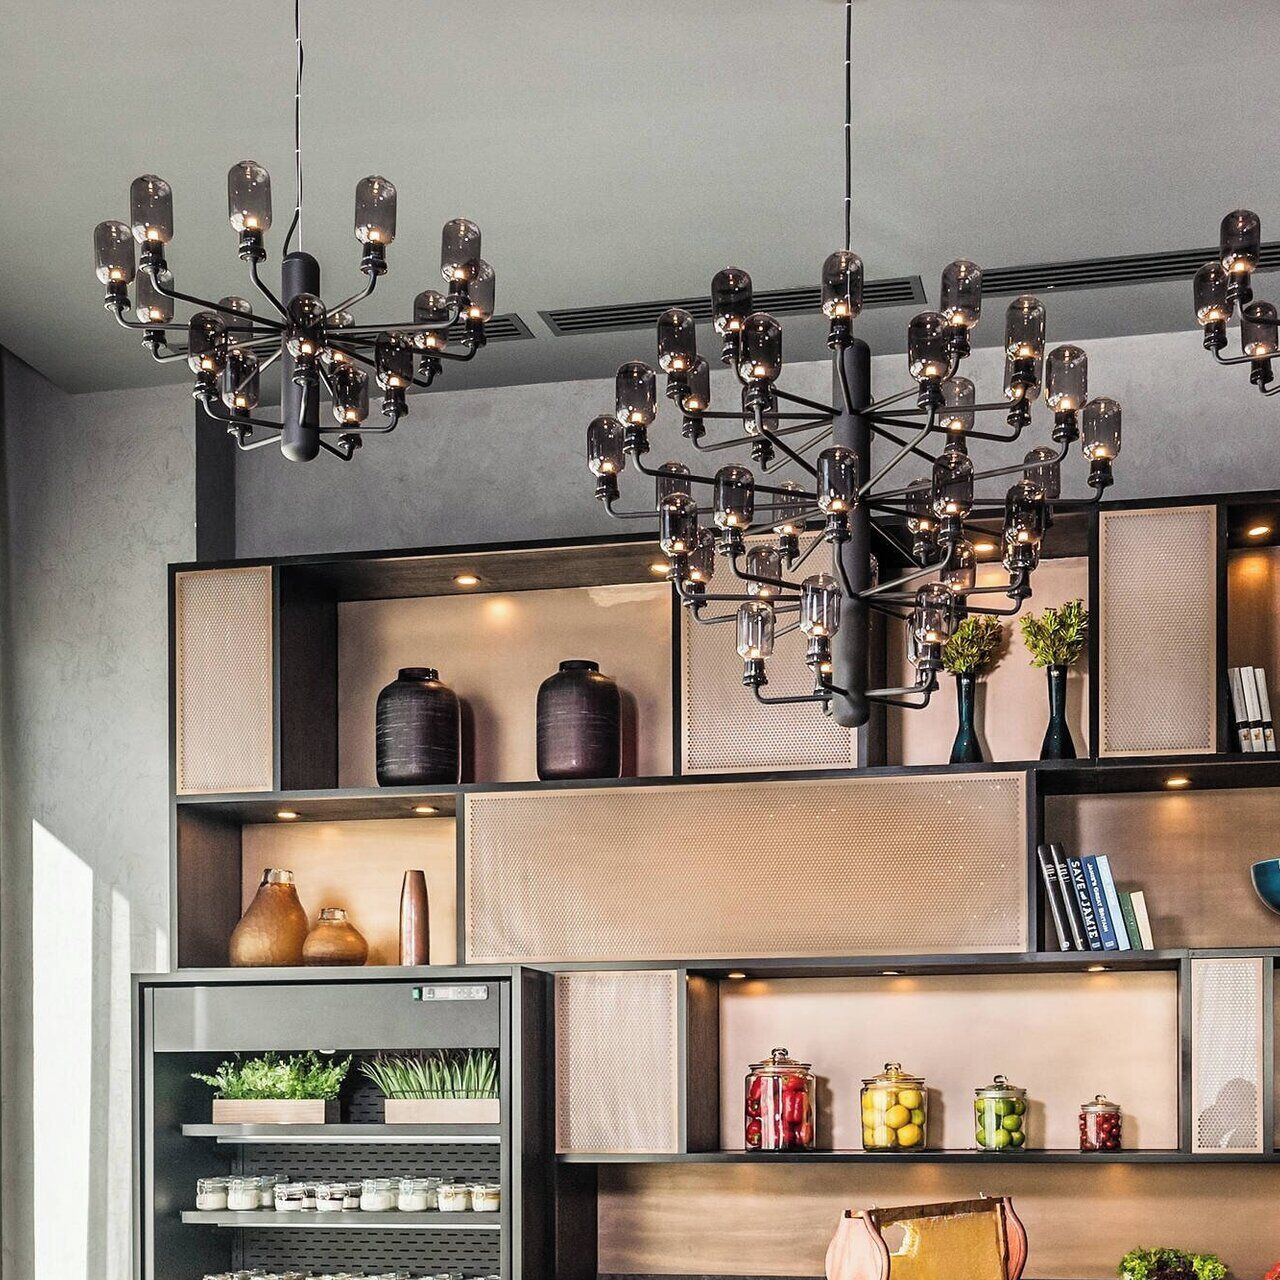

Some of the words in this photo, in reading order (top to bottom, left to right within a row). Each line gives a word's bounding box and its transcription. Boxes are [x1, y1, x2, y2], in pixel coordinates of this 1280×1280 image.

[1071, 861, 1086, 890] SAVE
[1081, 901, 1098, 939] JAMIE
[1093, 887, 1102, 907] GREAT
[1098, 907, 1109, 933] BRITAIN
